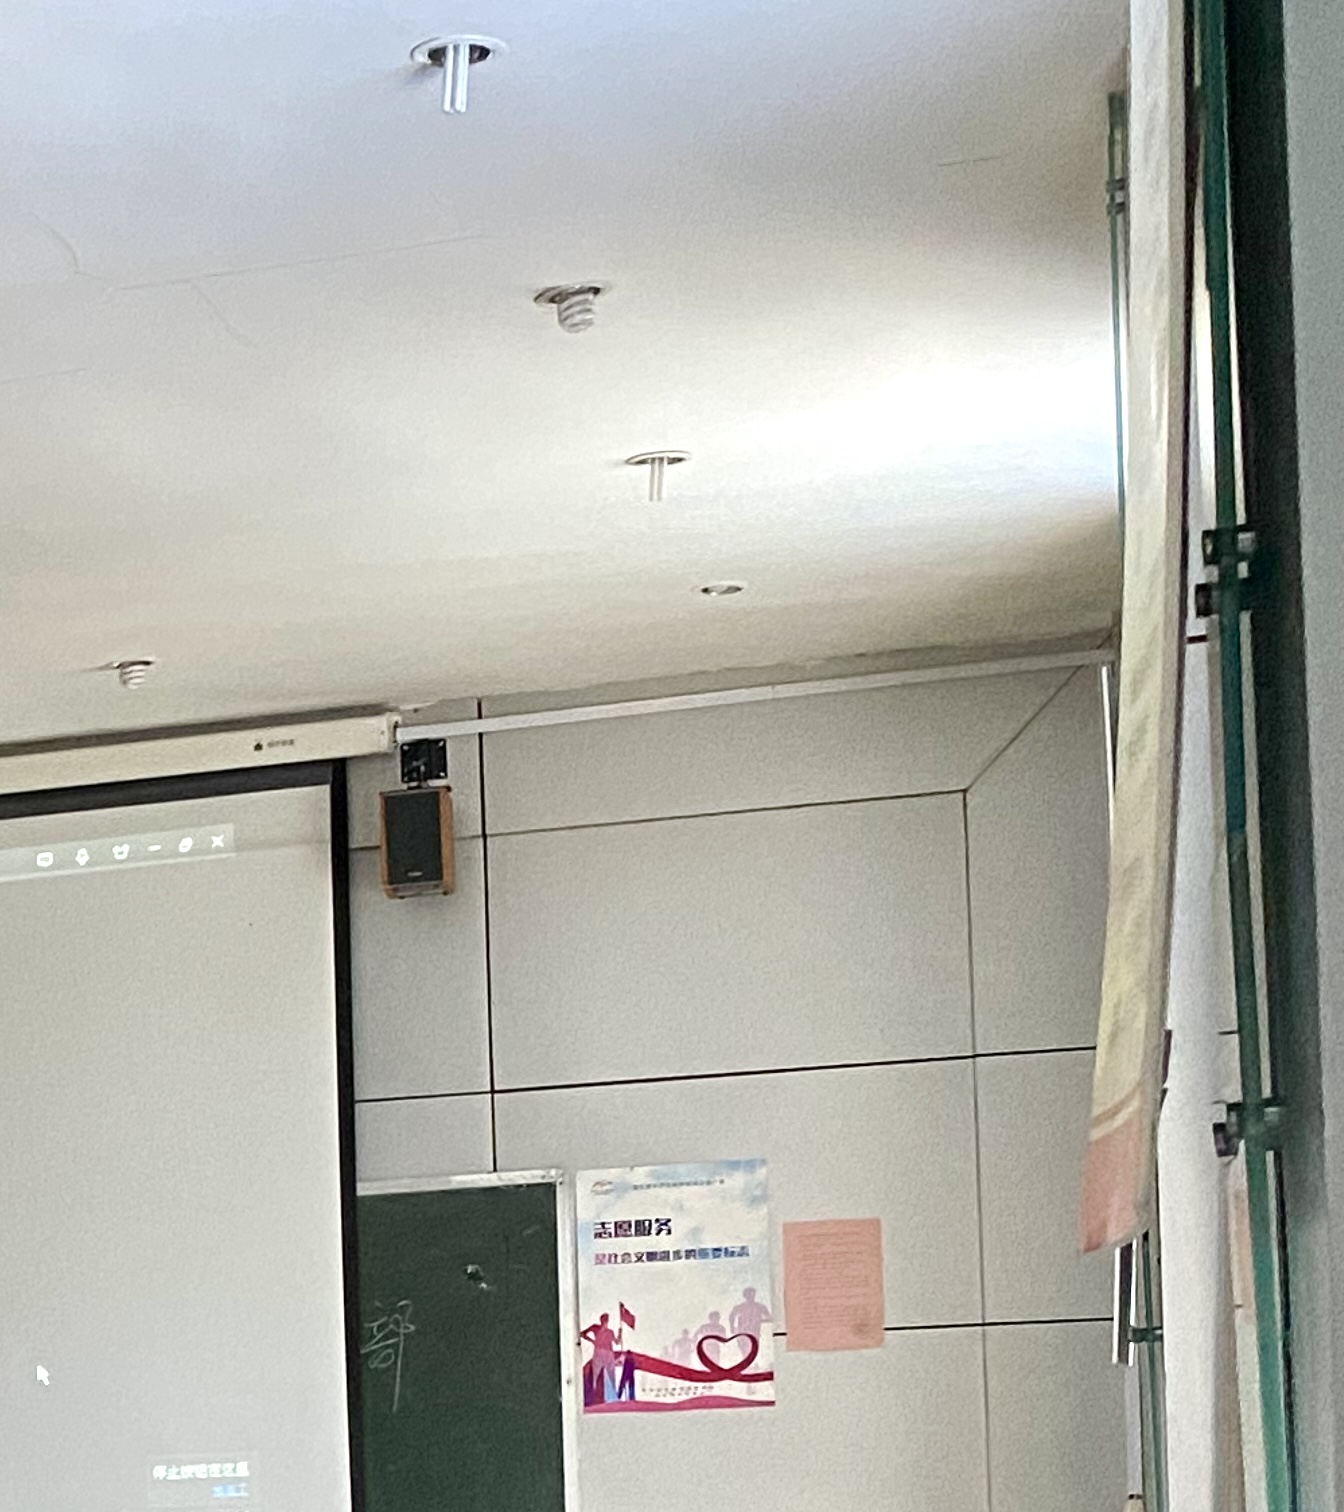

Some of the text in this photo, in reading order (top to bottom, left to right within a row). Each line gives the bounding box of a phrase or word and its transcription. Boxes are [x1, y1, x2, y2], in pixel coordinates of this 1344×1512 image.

[593, 1217, 673, 1240] 志愿服务
[594, 1245, 751, 1266] 是社会文明进步的重要标志
